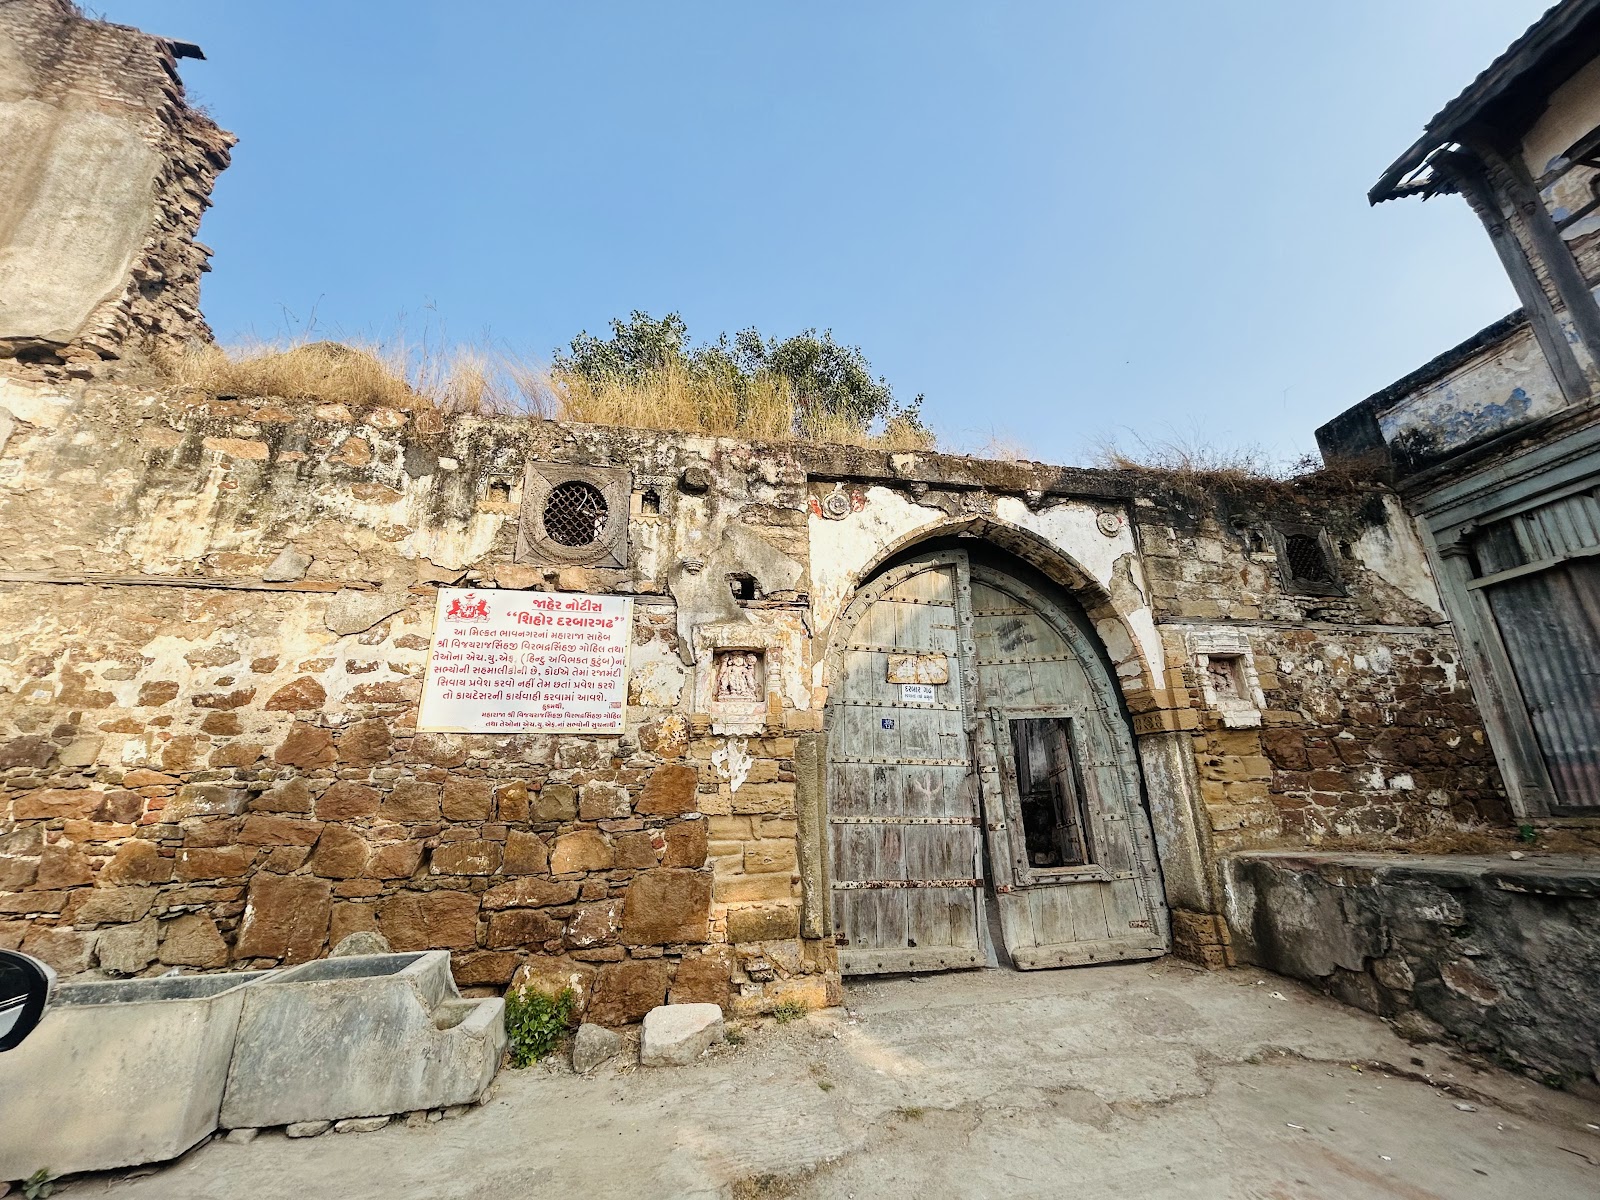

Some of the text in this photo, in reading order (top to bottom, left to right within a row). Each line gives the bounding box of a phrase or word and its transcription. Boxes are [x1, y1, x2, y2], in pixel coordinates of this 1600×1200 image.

[533, 597, 602, 612] જાહેર નોટીસ
[469, 627, 497, 637] મિલ્કત
[500, 628, 548, 638] ભાવનગરનાં
[551, 631, 584, 640] મહારાજા
[587, 632, 610, 641] સાહેબ
[437, 640, 448, 648] શ્રી
[579, 643, 605, 653] ગોહિલ
[608, 646, 624, 654] તથા
[432, 652, 463, 661] તેઓના
[434, 665, 470, 674] સભ્યોની
[545, 666, 569, 676] કોઈએ
[572, 666, 588, 677] તેમાં
[437, 676, 466, 687] સિવાય
[469, 678, 491, 687] પ્રવેશ
[494, 678, 515, 688] કરવો
[537, 678, 550, 688] તેમ
[554, 679, 571, 689] છતાં
[574, 680, 595, 689] પ્રવેશ
[598, 681, 615, 690] કરશે
[443, 690, 453, 699] તો
[456, 690, 502, 700] કાયદેસરની
[506, 691, 541, 701] કાર્યવાહી
[544, 692, 574, 702] કરવામાં
